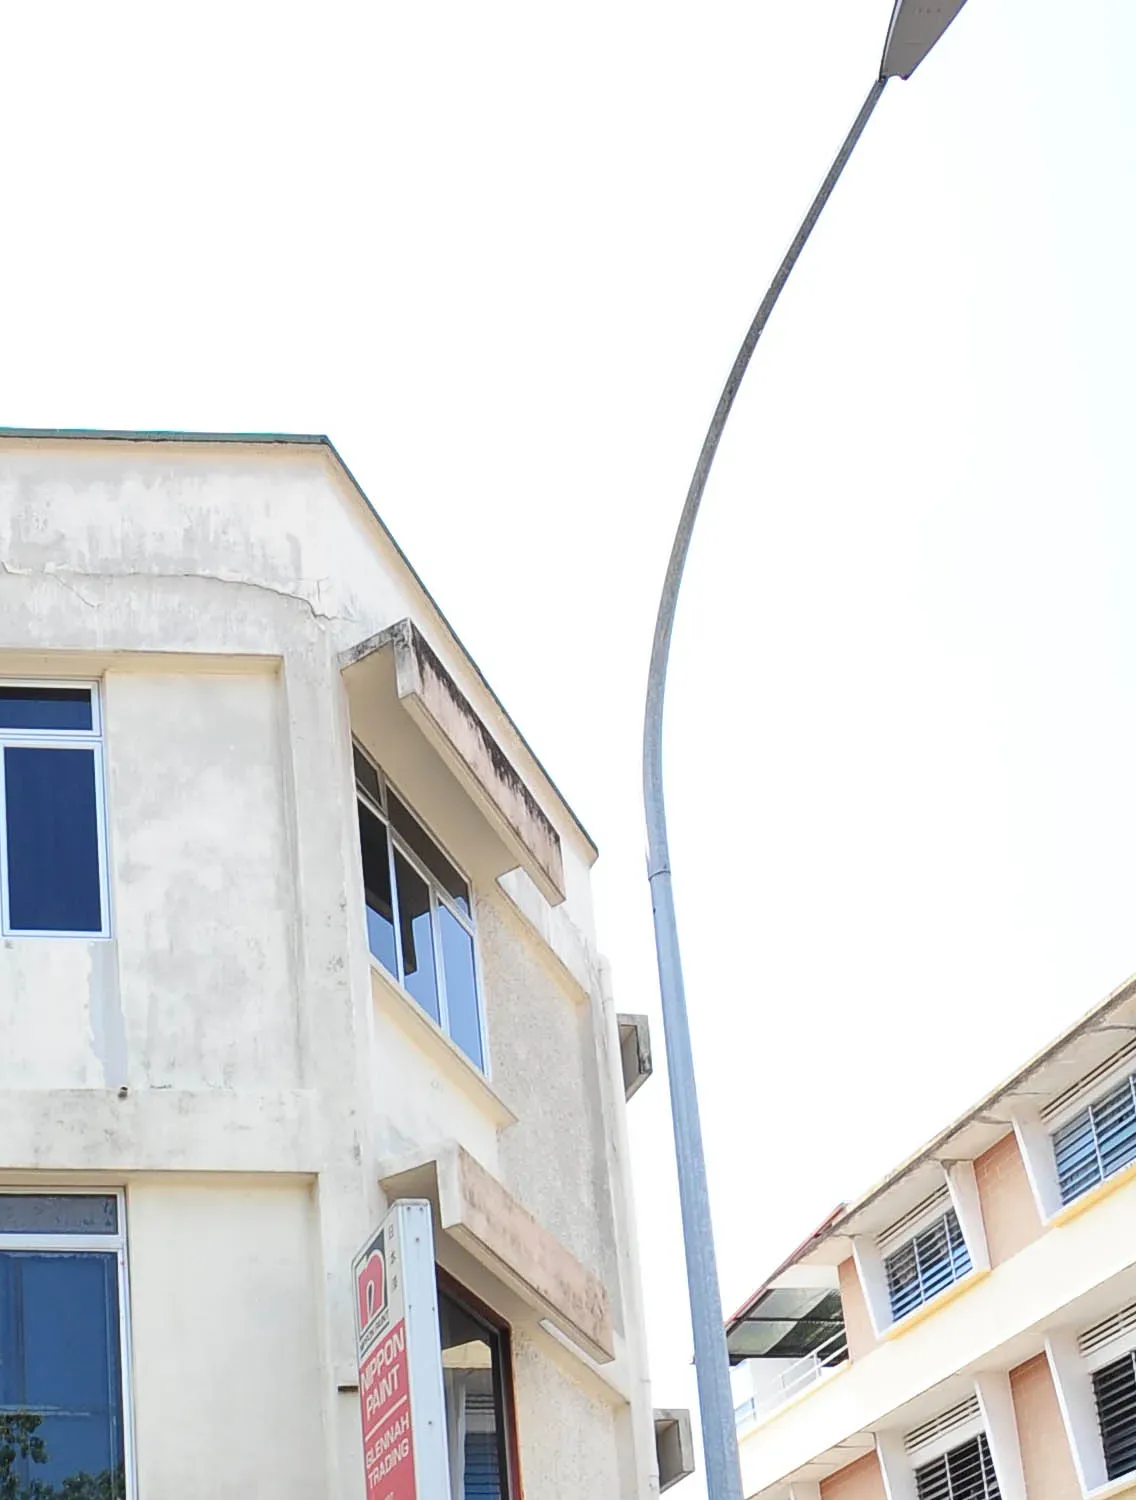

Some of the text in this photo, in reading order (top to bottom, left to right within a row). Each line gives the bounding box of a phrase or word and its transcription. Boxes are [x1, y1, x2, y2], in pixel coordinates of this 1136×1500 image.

[361, 1327, 405, 1396] NIPPON
[366, 1363, 400, 1421] PAINT
[366, 1410, 410, 1470] GLENNAH
[367, 1437, 410, 1489] TRADING
